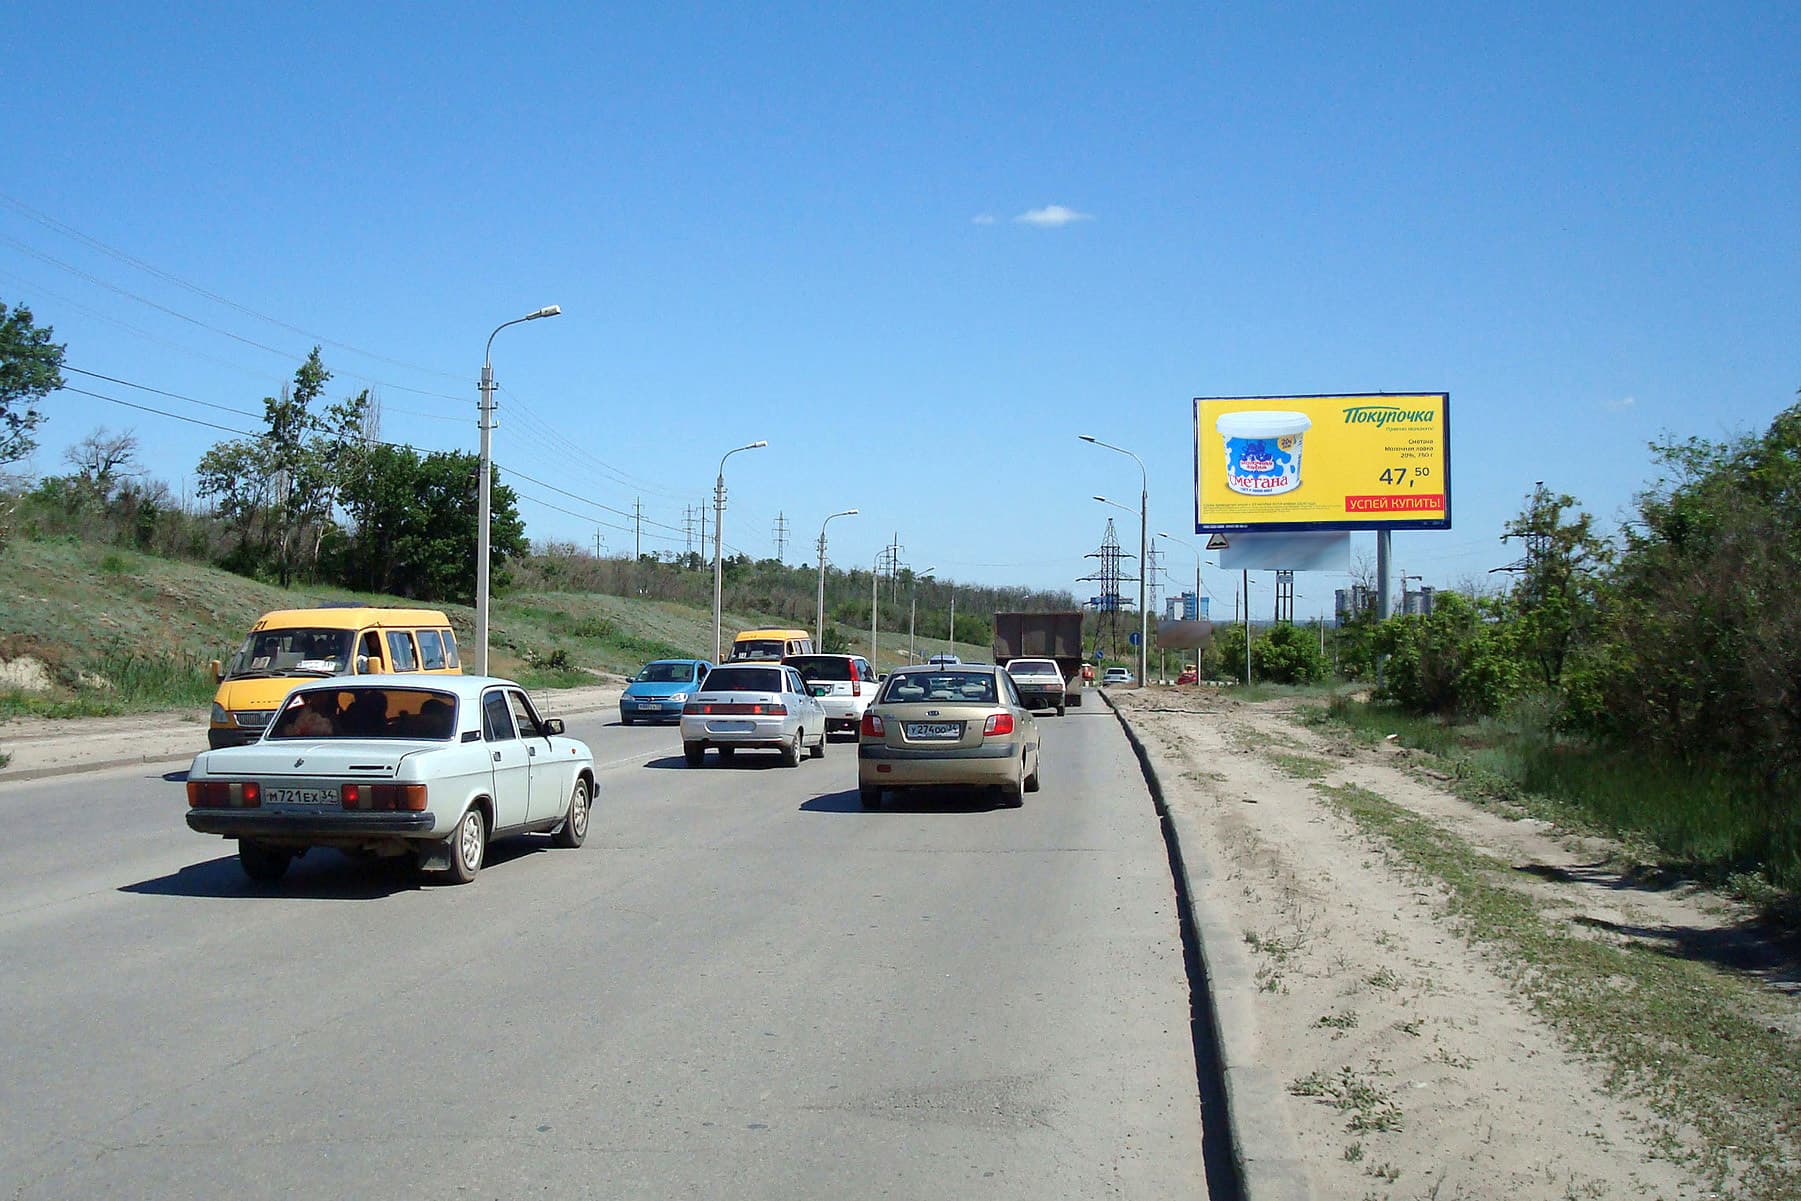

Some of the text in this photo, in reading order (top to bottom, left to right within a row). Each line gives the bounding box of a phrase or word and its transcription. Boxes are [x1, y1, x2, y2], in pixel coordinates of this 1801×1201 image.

[1342, 406, 1434, 428] Покупочка
[1350, 497, 1388, 509] УСПЕЙ
[1391, 497, 1441, 509] КУПИТЬ!
